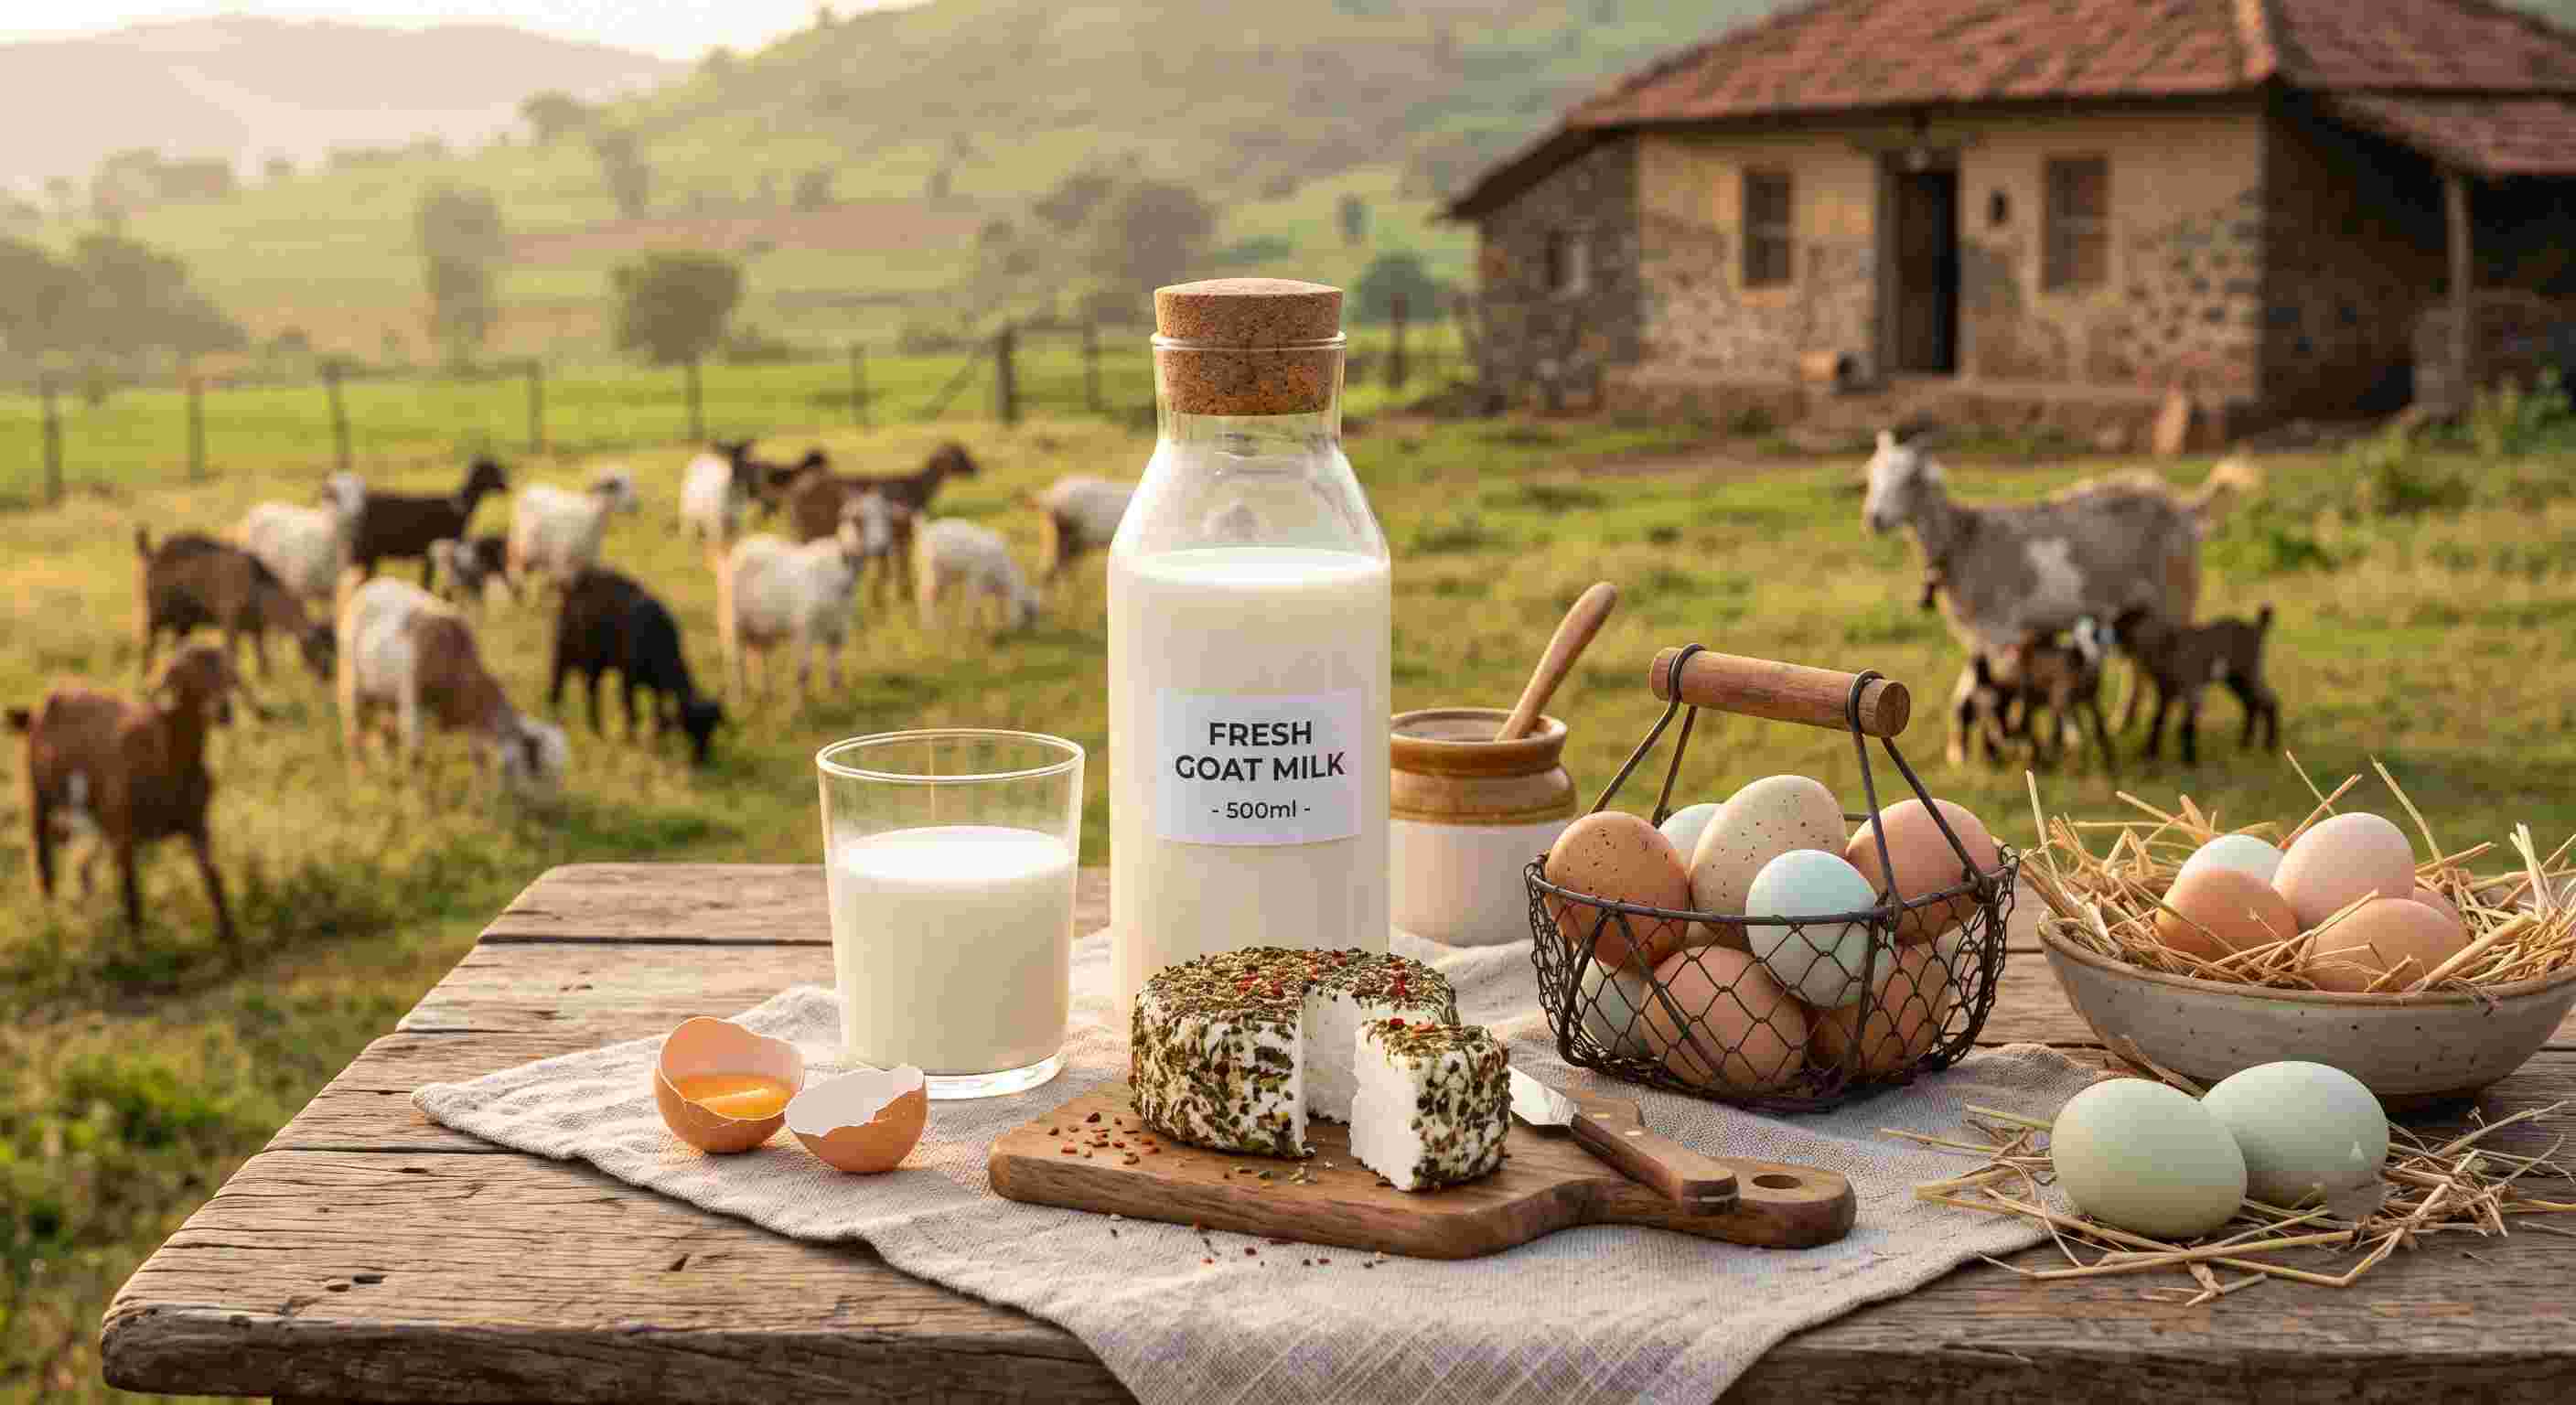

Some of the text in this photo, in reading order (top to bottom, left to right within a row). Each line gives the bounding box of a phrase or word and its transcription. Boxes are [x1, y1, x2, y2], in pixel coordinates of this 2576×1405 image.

[1208, 721, 1312, 746] FRESH
[1175, 751, 1346, 782] GOAT MILK
[1226, 799, 1296, 819] 500ml
